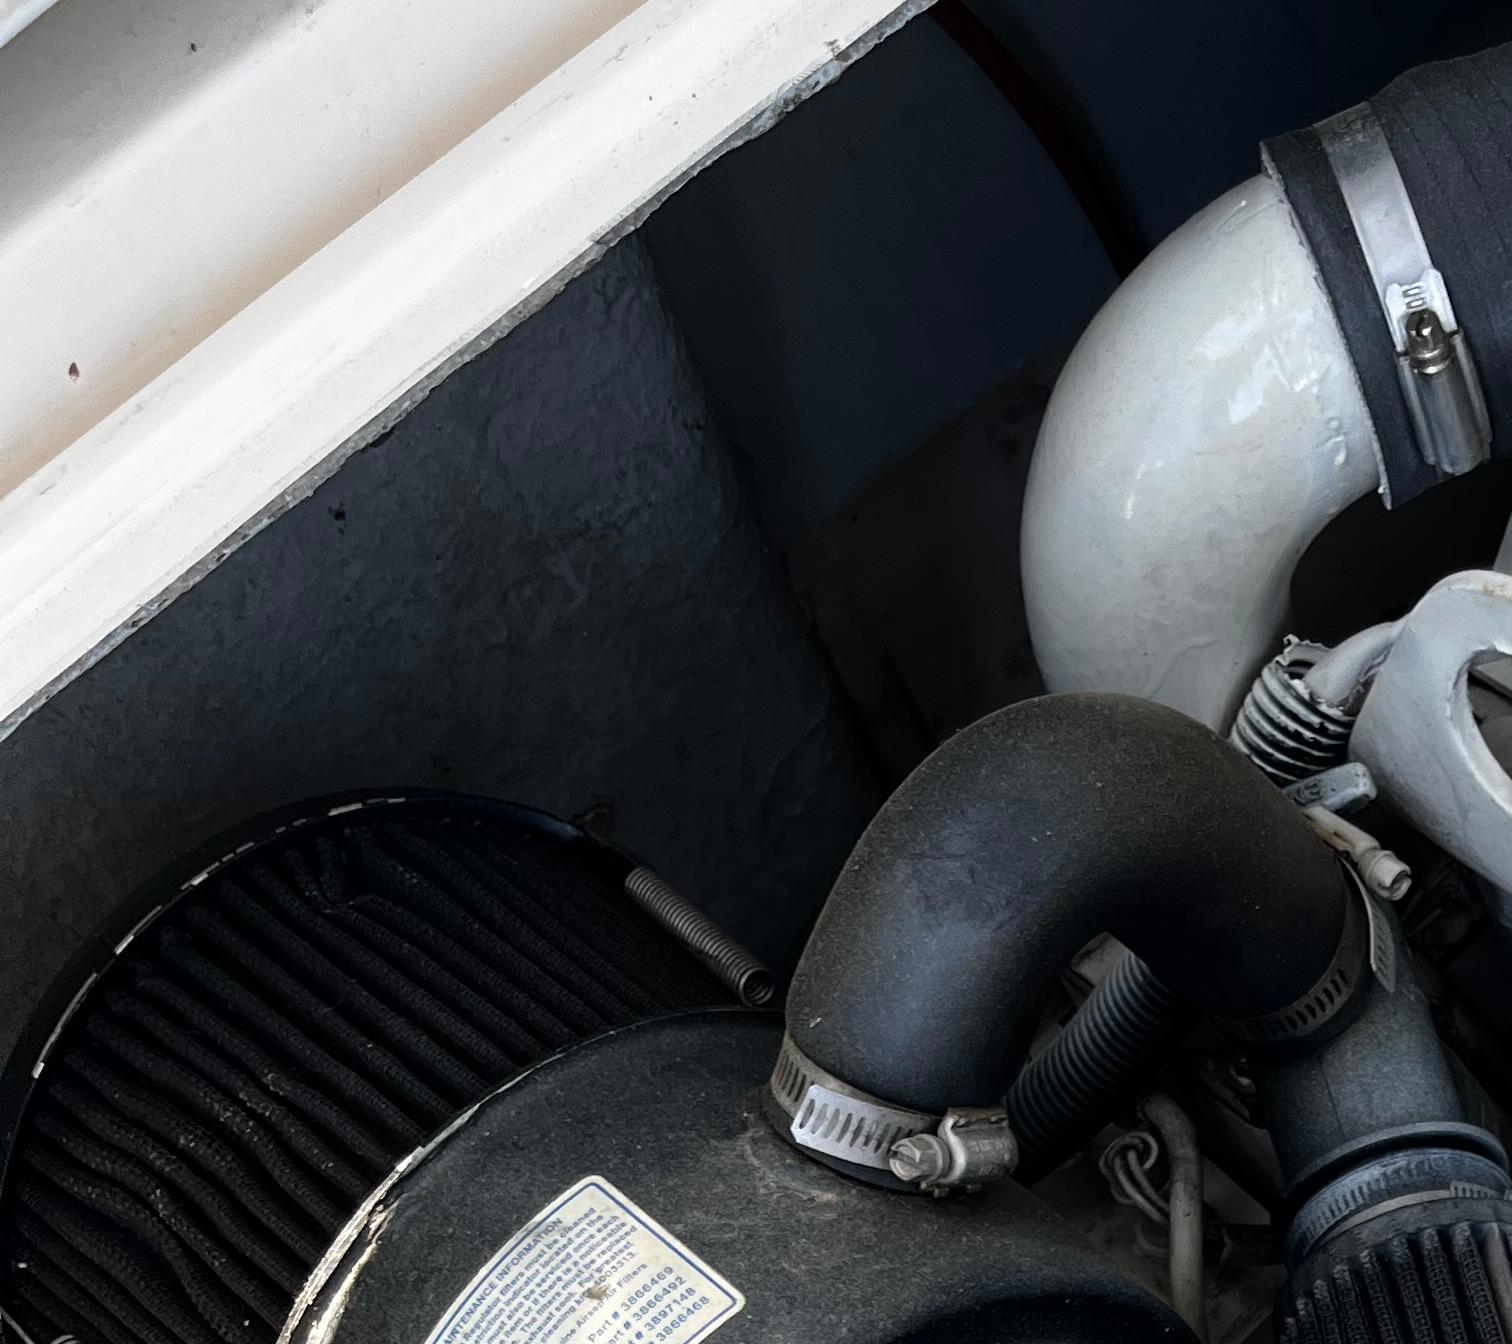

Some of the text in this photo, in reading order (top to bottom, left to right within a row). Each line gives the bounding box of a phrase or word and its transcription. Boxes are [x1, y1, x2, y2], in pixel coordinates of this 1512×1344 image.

[462, 1294, 503, 1342] Regulator
[498, 1269, 526, 1297] filters
[522, 1248, 548, 1272] must
[557, 1206, 597, 1239] cleaned
[484, 1319, 508, 1344] must
[504, 1299, 525, 1321] also
[533, 1251, 574, 1289] serviced
[571, 1232, 596, 1254] once
[593, 1212, 620, 1234] each
[494, 1216, 564, 1282] INFORMATION
[502, 1267, 542, 1308] indicator
[538, 1236, 575, 1270] located
[585, 1212, 604, 1228] the
[502, 1315, 524, 1339] item
[537, 1274, 564, 1299] there
[577, 1219, 627, 1261] noticeable
[519, 1314, 539, 1334] The
[534, 1289, 563, 1317] filters
[559, 1267, 585, 1291] must
[595, 1223, 638, 1260] replaced
[577, 1271, 596, 1288] For
[593, 1239, 634, 1275] greatest
[602, 1286, 619, 1301] Air
[616, 1260, 648, 1289] Filters
[537, 1303, 578, 1344] cleaning
[586, 1318, 614, 1344] Part
[609, 1309, 622, 1321] #
[619, 1263, 675, 1313] 3866469
[621, 1320, 634, 1331] #
[630, 1272, 687, 1324] 3866492
[633, 1330, 645, 1341] #
[642, 1284, 697, 1334] 3897148
[654, 1292, 711, 1344] 3866468
